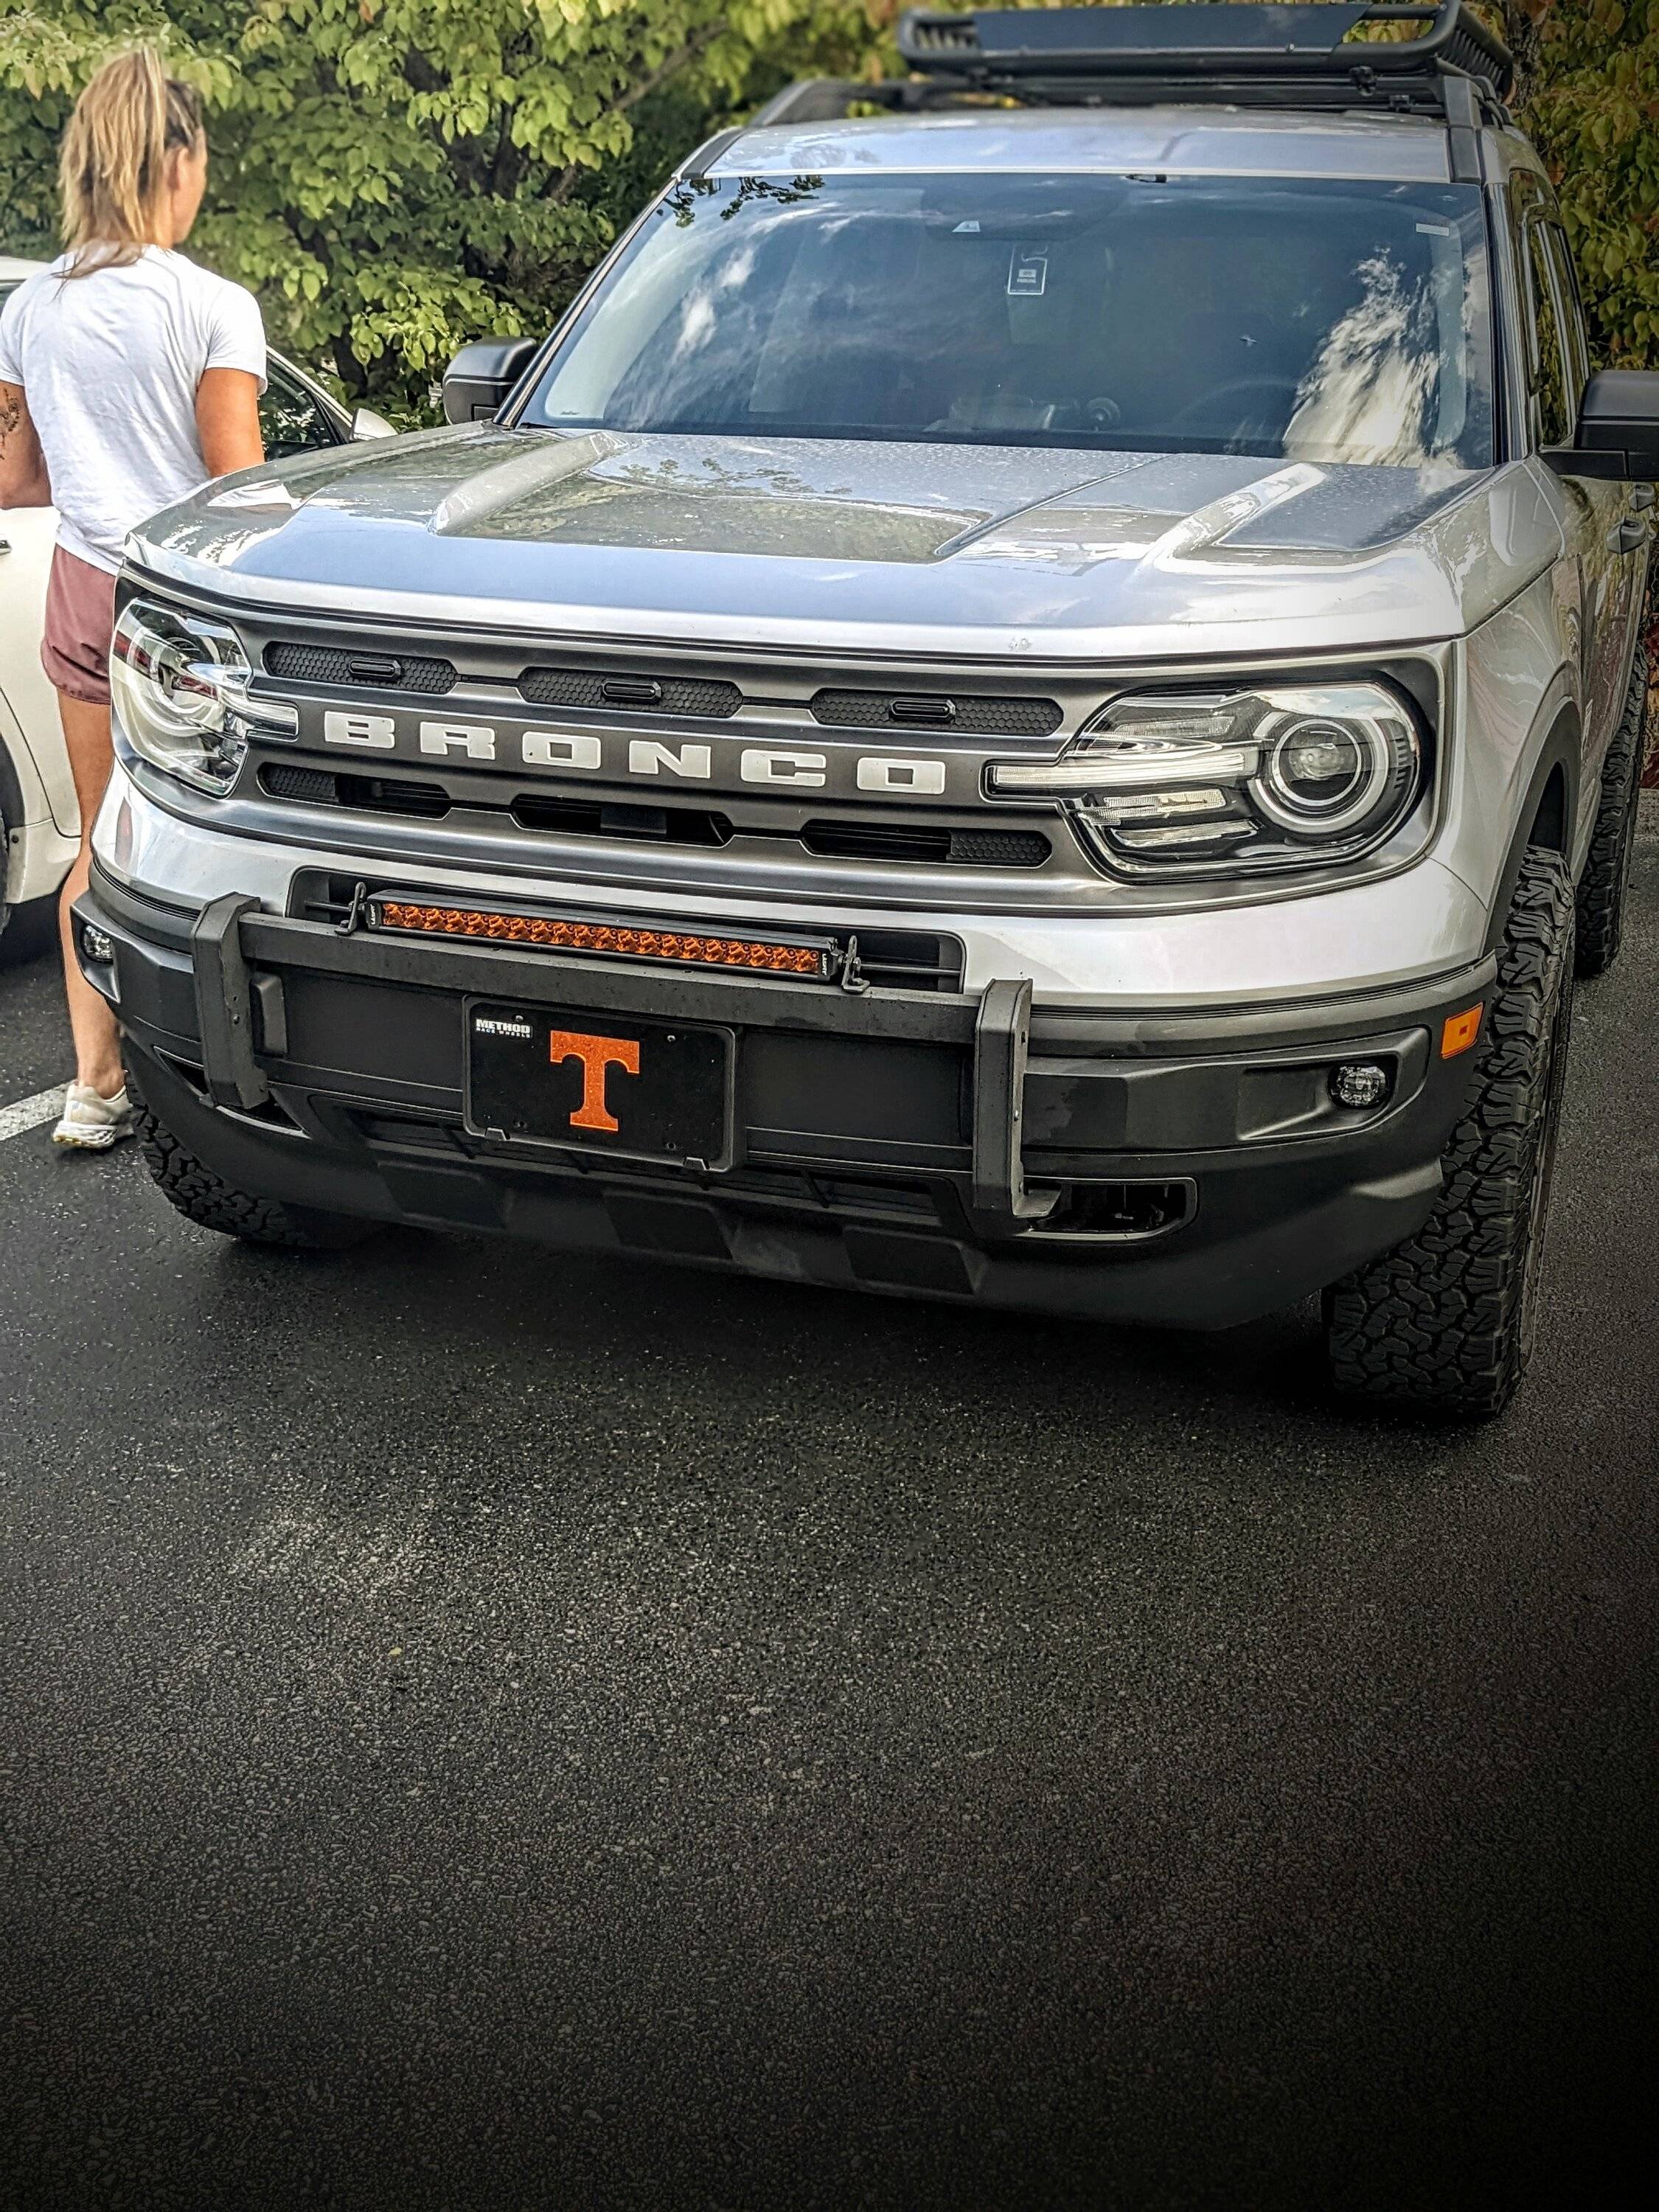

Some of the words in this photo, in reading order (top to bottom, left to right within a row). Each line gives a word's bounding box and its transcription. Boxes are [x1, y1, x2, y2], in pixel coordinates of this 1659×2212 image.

[324, 710, 946, 796] BRONCO
[476, 1018, 531, 1034] METHOD
[549, 1029, 640, 1132] T
